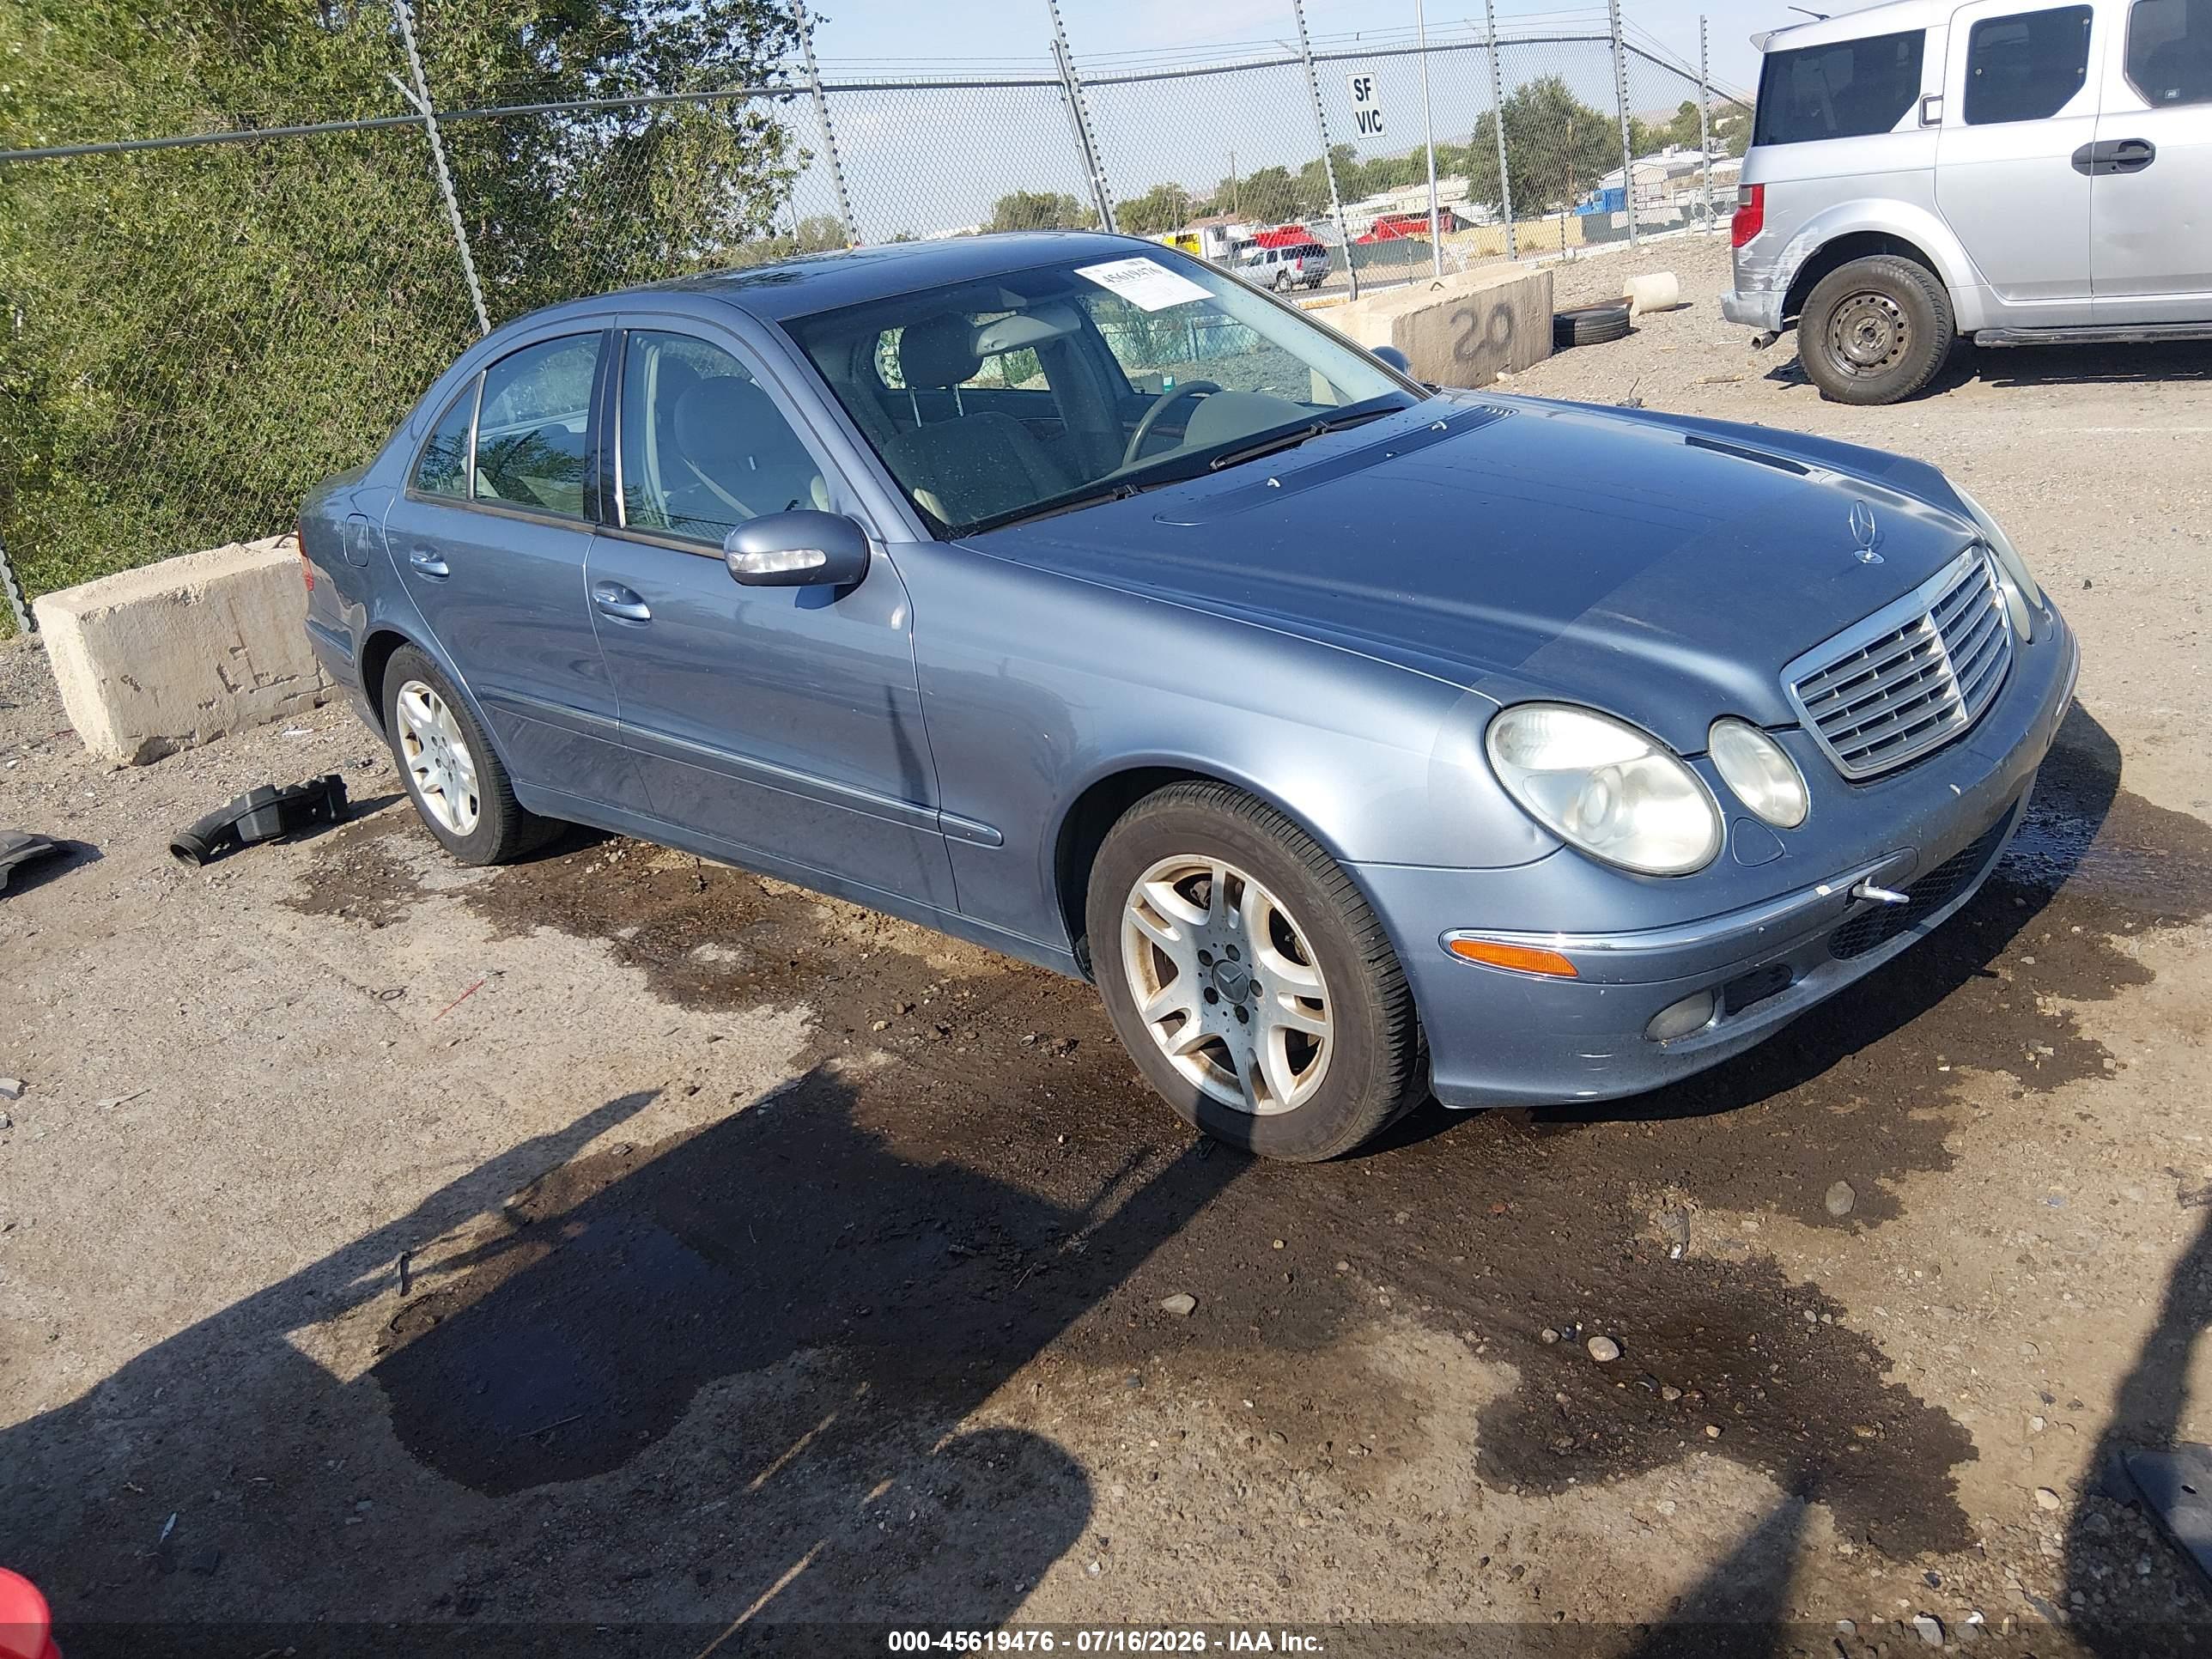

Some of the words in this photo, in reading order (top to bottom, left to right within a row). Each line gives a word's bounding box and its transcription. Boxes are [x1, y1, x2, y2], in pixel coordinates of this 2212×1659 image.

[1353, 77, 1371, 102] SF
[1355, 109, 1382, 133] VIC
[1449, 302, 1515, 362] 20
